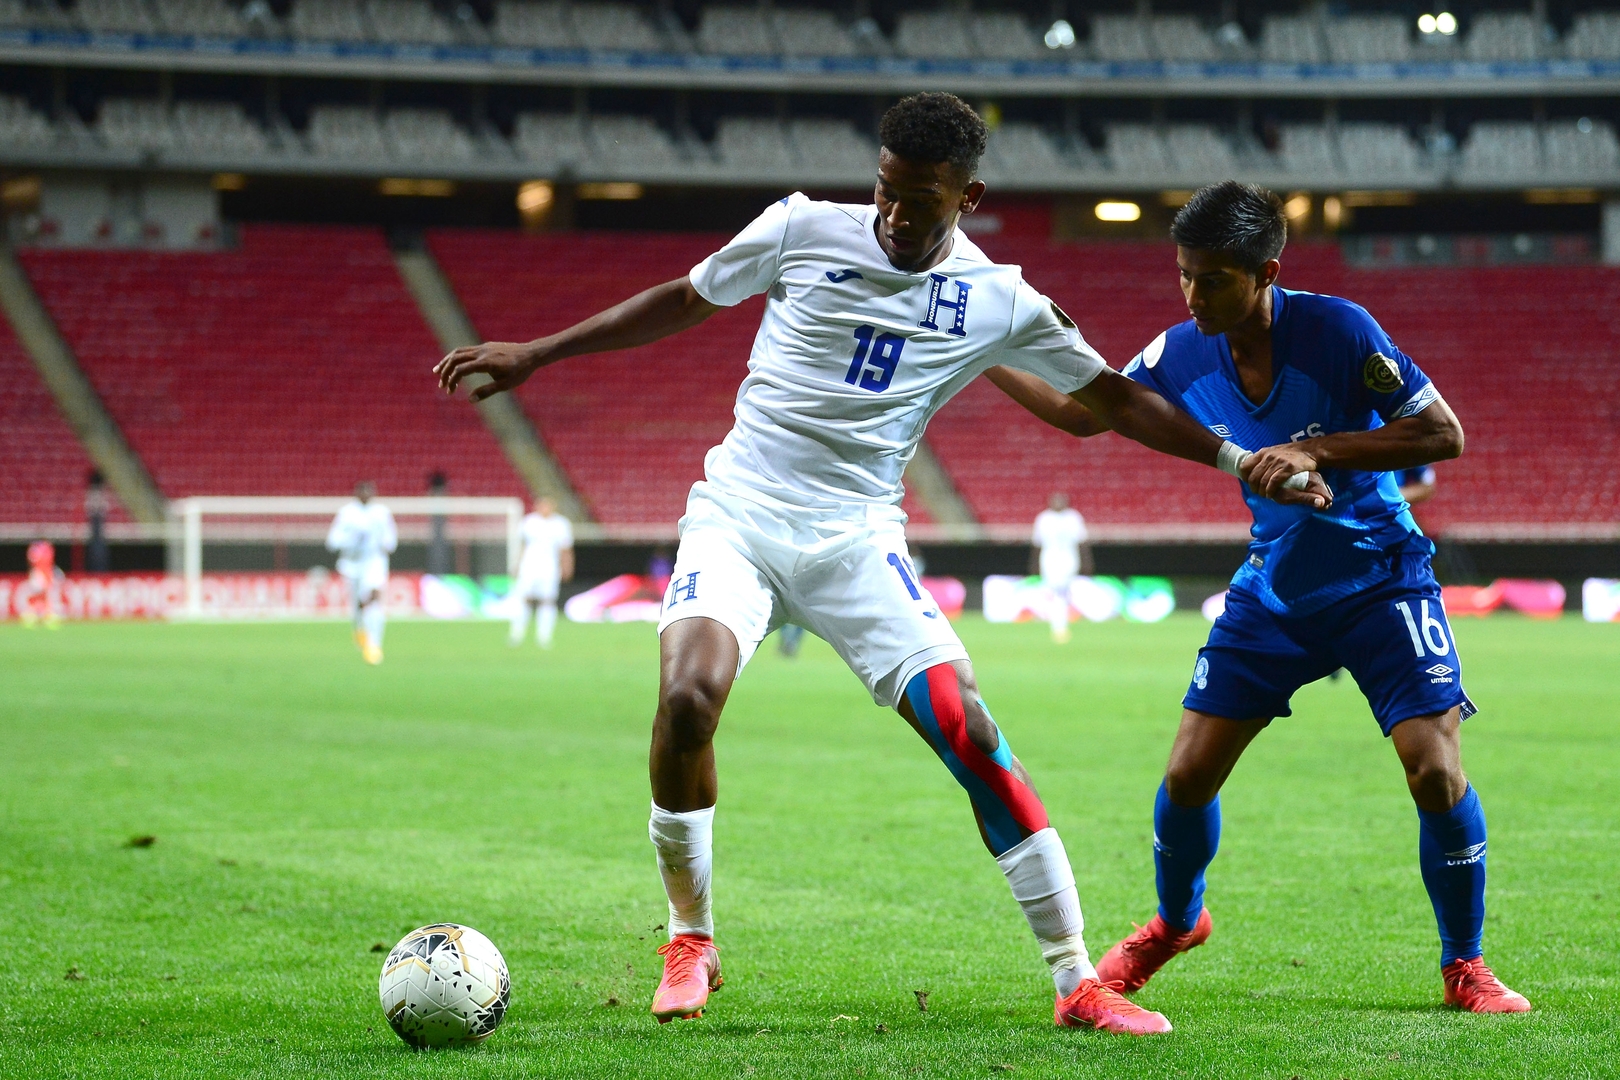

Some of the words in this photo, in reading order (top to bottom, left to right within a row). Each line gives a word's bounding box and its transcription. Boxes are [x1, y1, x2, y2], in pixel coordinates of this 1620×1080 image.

[918, 272, 973, 337] H
[928, 281, 940, 323] HONDURAS
[844, 324, 906, 393] 19
[196, 576, 415, 613] QUALIFYG
[886, 552, 922, 601] 1
[1394, 599, 1450, 658] 16
[1430, 676, 1453, 684] umbro
[1446, 849, 1486, 866] umbro
